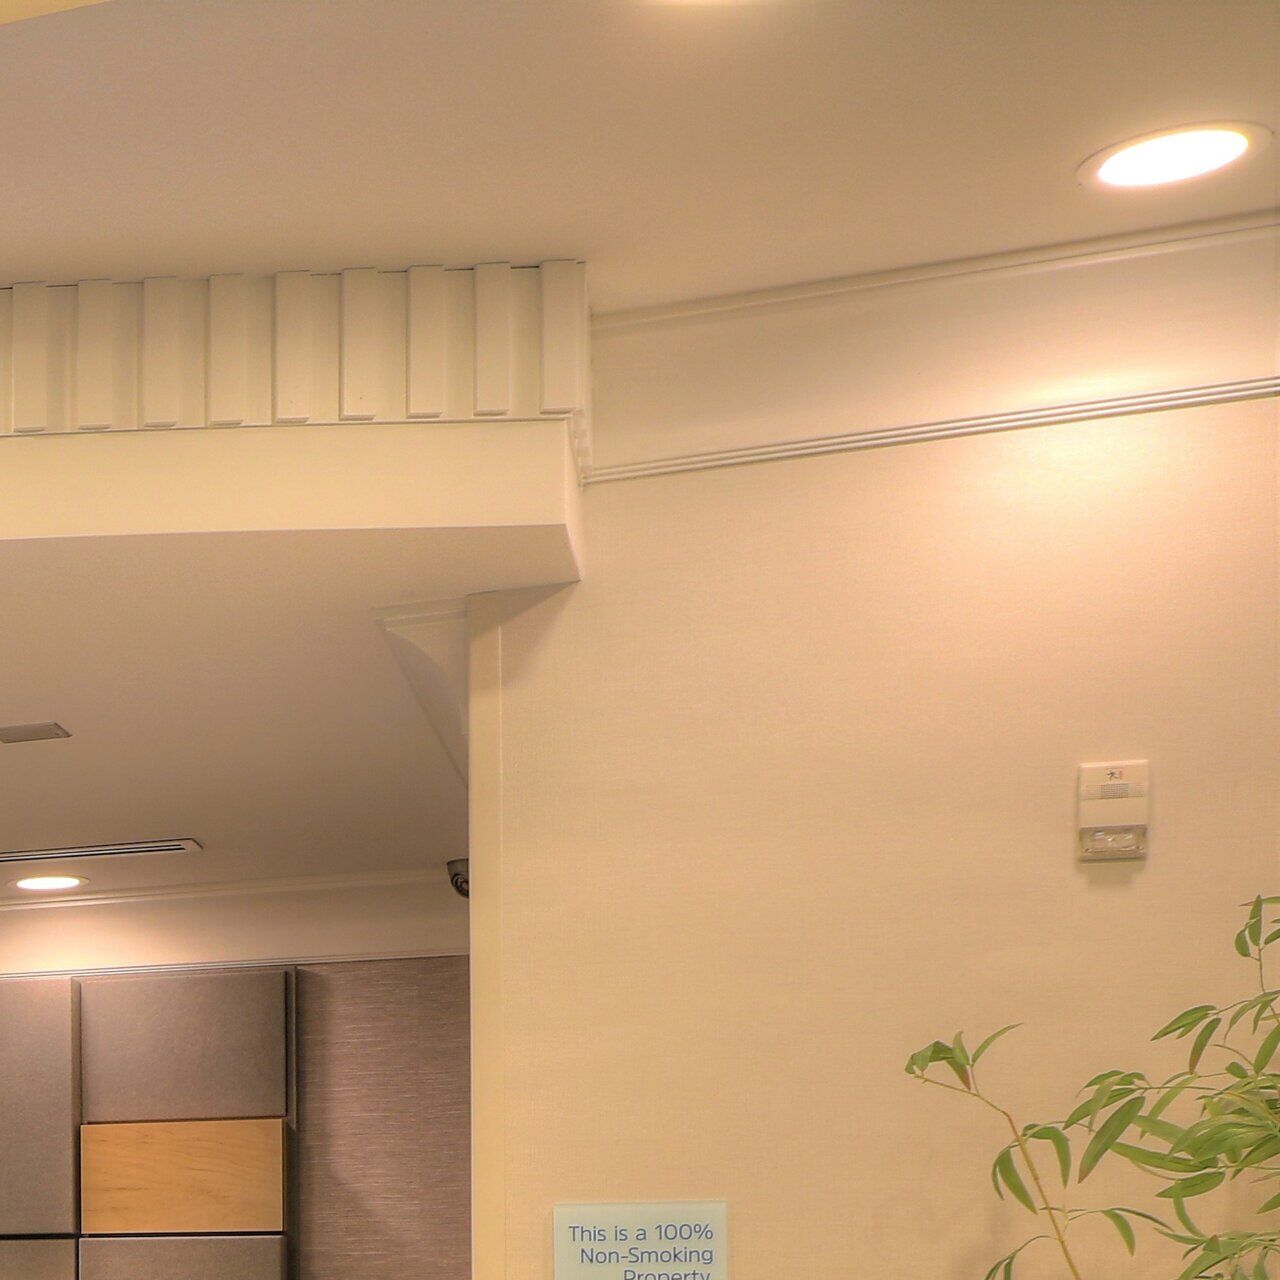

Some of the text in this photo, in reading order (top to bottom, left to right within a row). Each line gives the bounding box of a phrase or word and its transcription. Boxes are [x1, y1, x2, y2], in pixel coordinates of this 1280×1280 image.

[568, 1223, 714, 1242] This is a 100%
[580, 1246, 714, 1265] Non-Smoking
